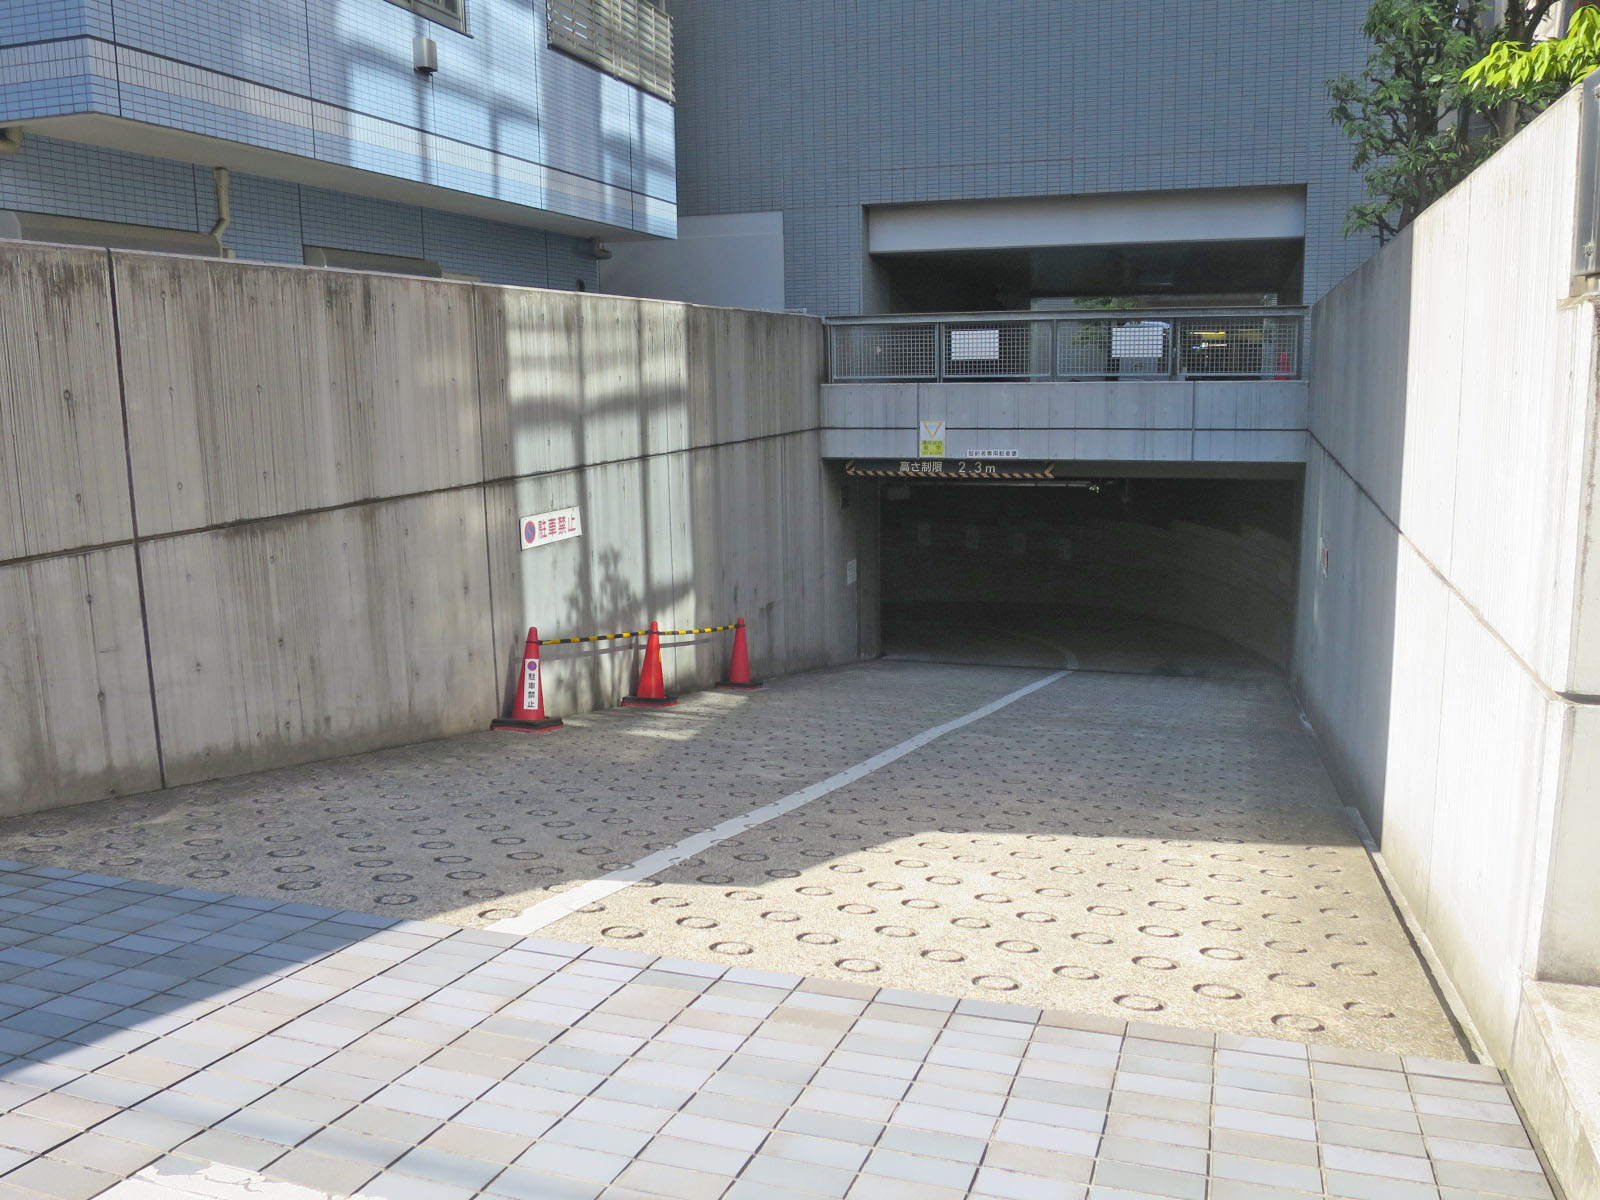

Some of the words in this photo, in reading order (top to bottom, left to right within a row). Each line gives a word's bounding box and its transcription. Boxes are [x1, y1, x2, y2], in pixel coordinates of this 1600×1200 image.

[900, 461, 943, 473] 高さ制限
[538, 513, 576, 539] 駐車禁止
[527, 672, 536, 708] 駐車禁止
